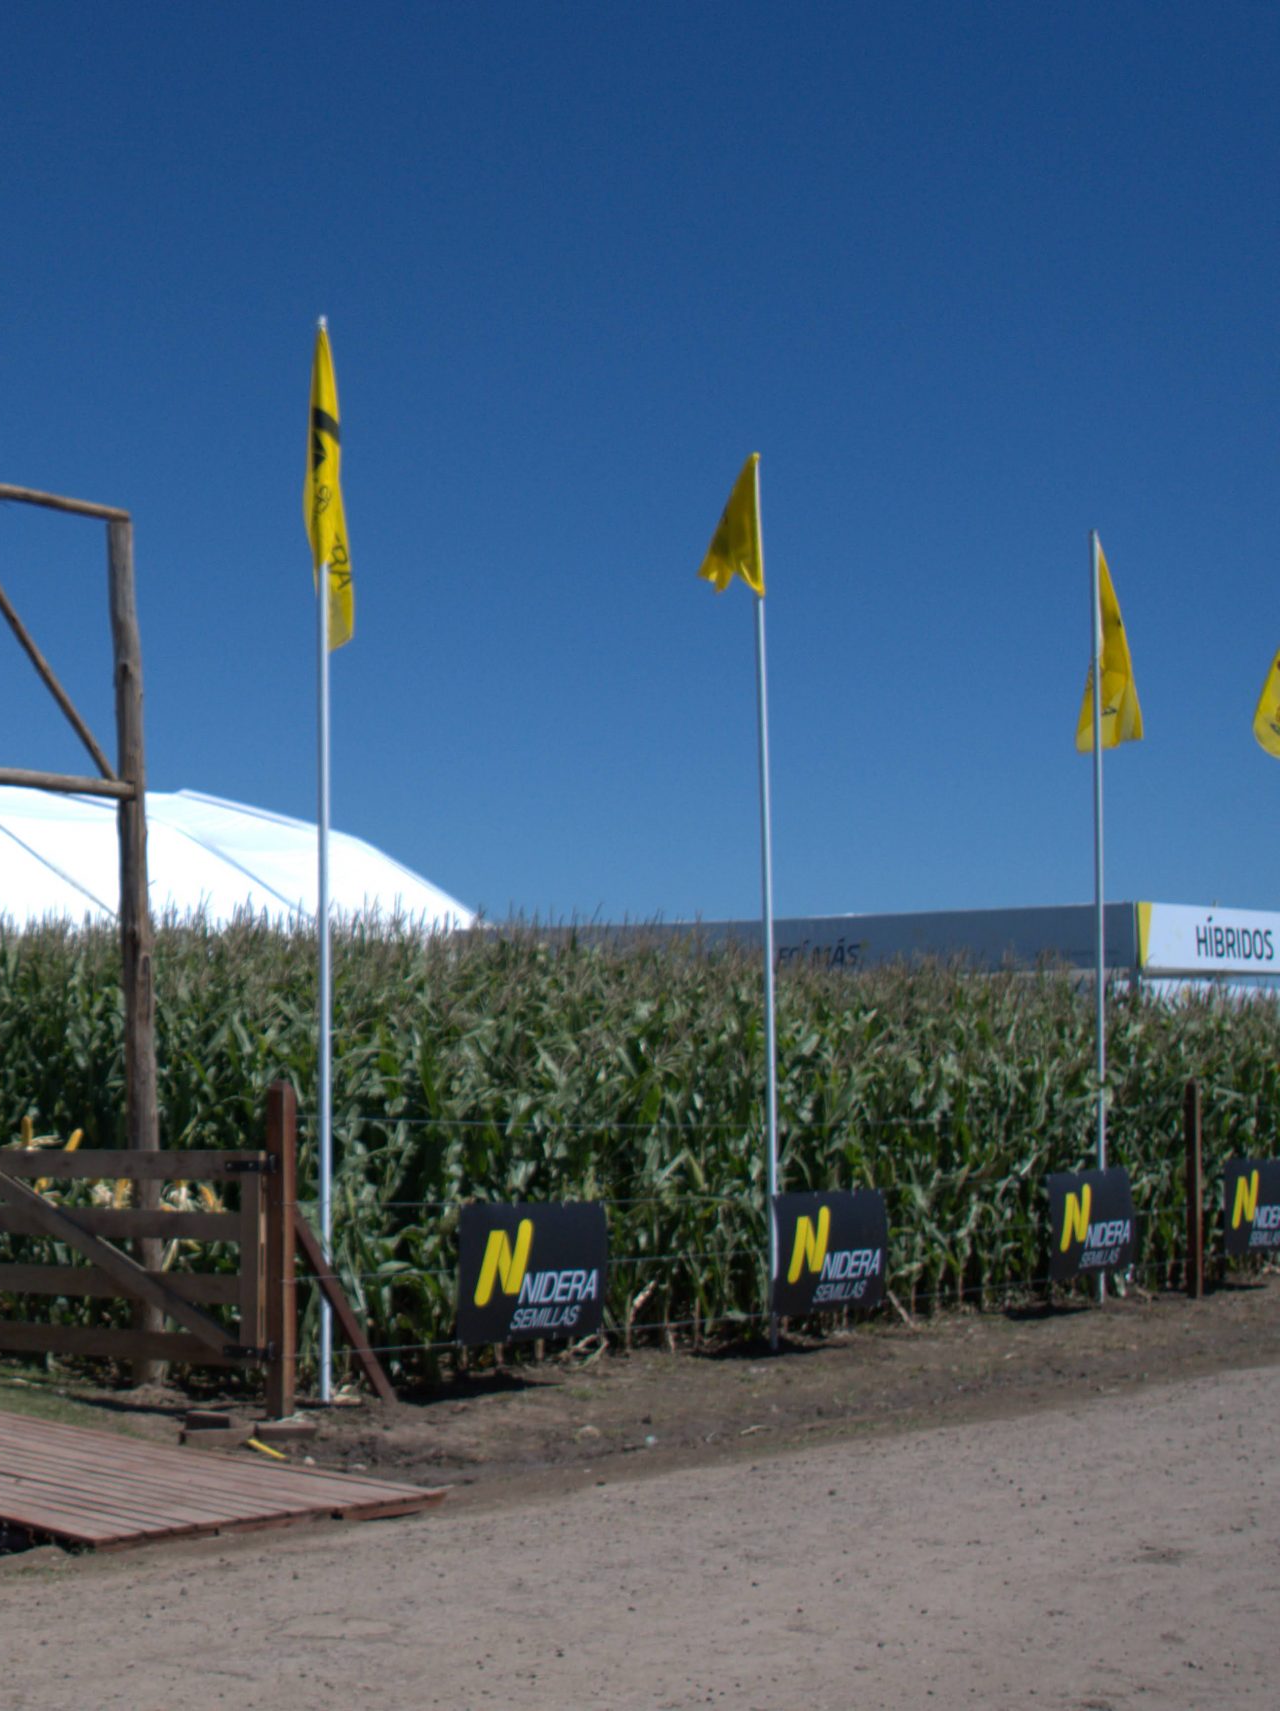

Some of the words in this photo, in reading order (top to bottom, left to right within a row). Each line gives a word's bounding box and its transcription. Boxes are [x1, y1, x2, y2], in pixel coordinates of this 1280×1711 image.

[1195, 914, 1275, 960] HÍBRIDOS
[1084, 1219, 1131, 1249] NIDERA
[819, 1248, 881, 1281] NIDERA
[517, 1268, 598, 1305] NIDERA
[812, 1280, 867, 1303] SEMILLAS
[510, 1304, 581, 1330] SEMILLAS
